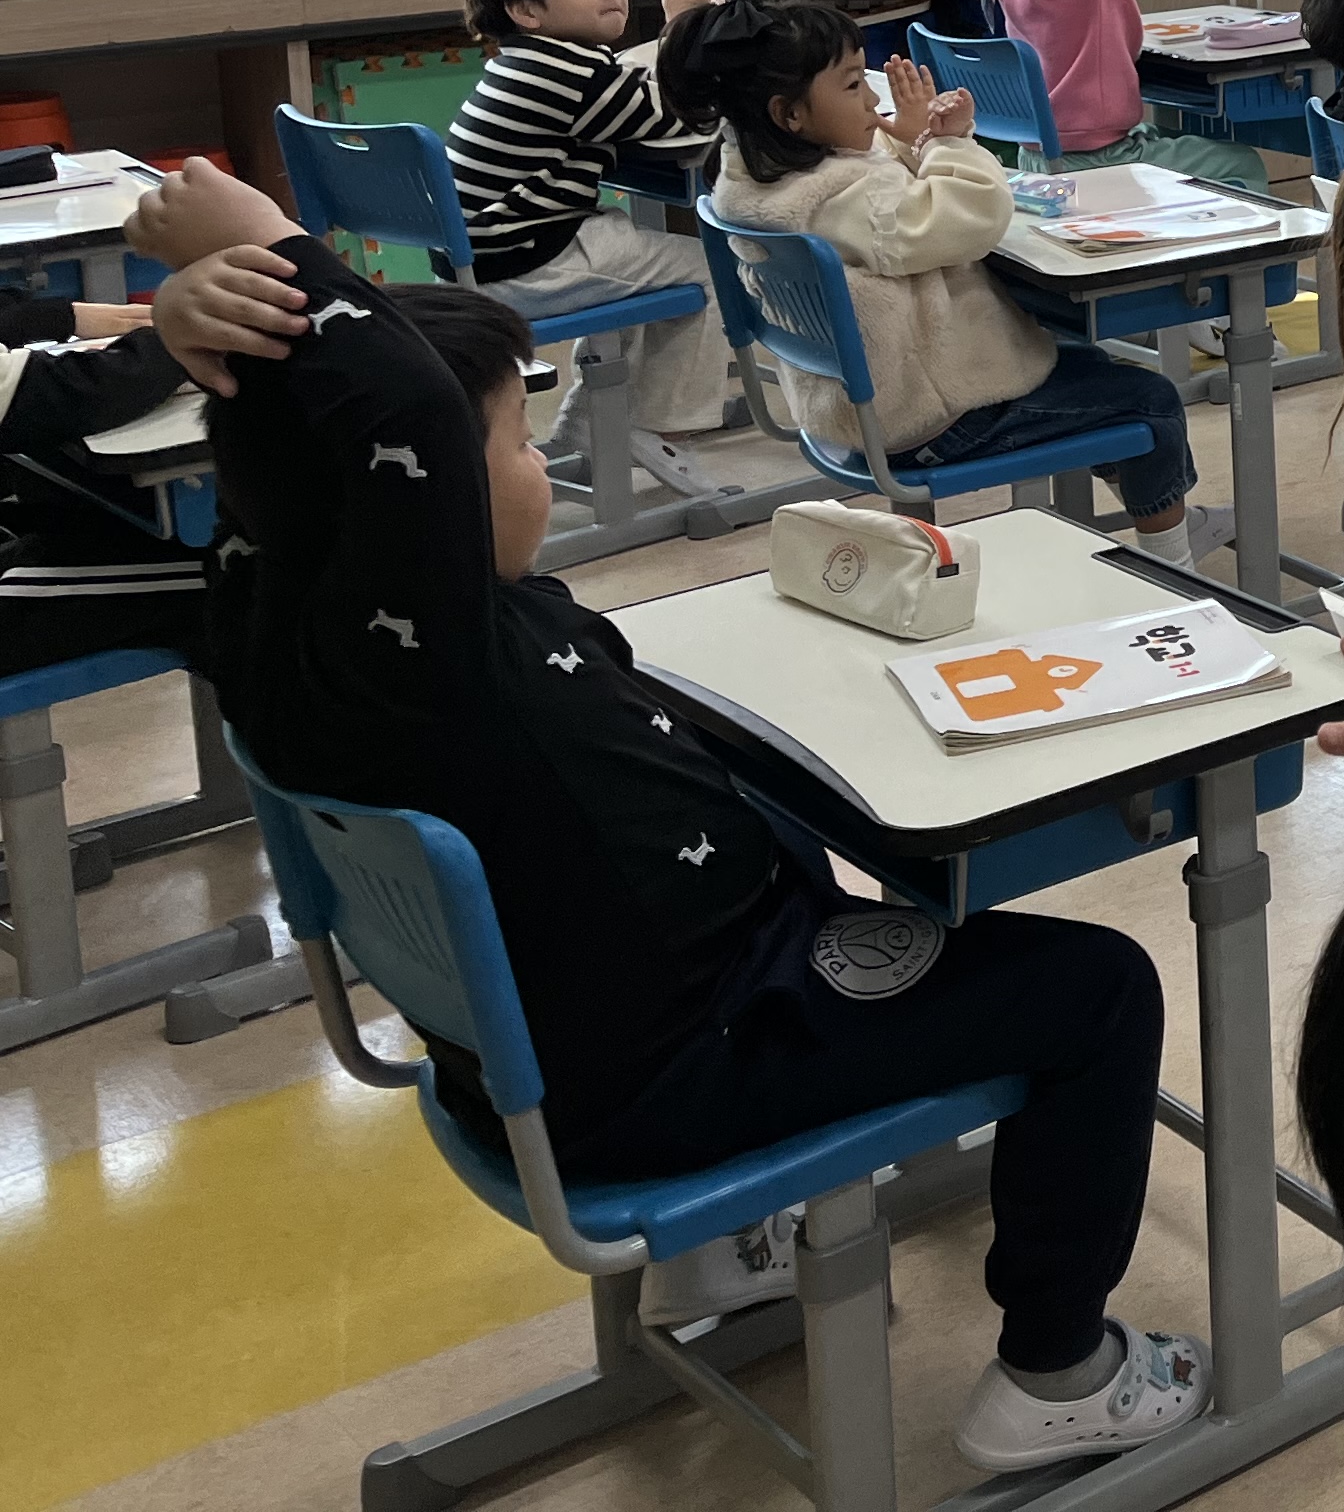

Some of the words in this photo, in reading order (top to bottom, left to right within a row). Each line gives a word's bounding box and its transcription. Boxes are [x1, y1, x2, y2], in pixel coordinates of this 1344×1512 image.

[1128, 625, 1197, 662] 학교
[1168, 661, 1201, 678] 1-1
[817, 923, 848, 975] PARIS
